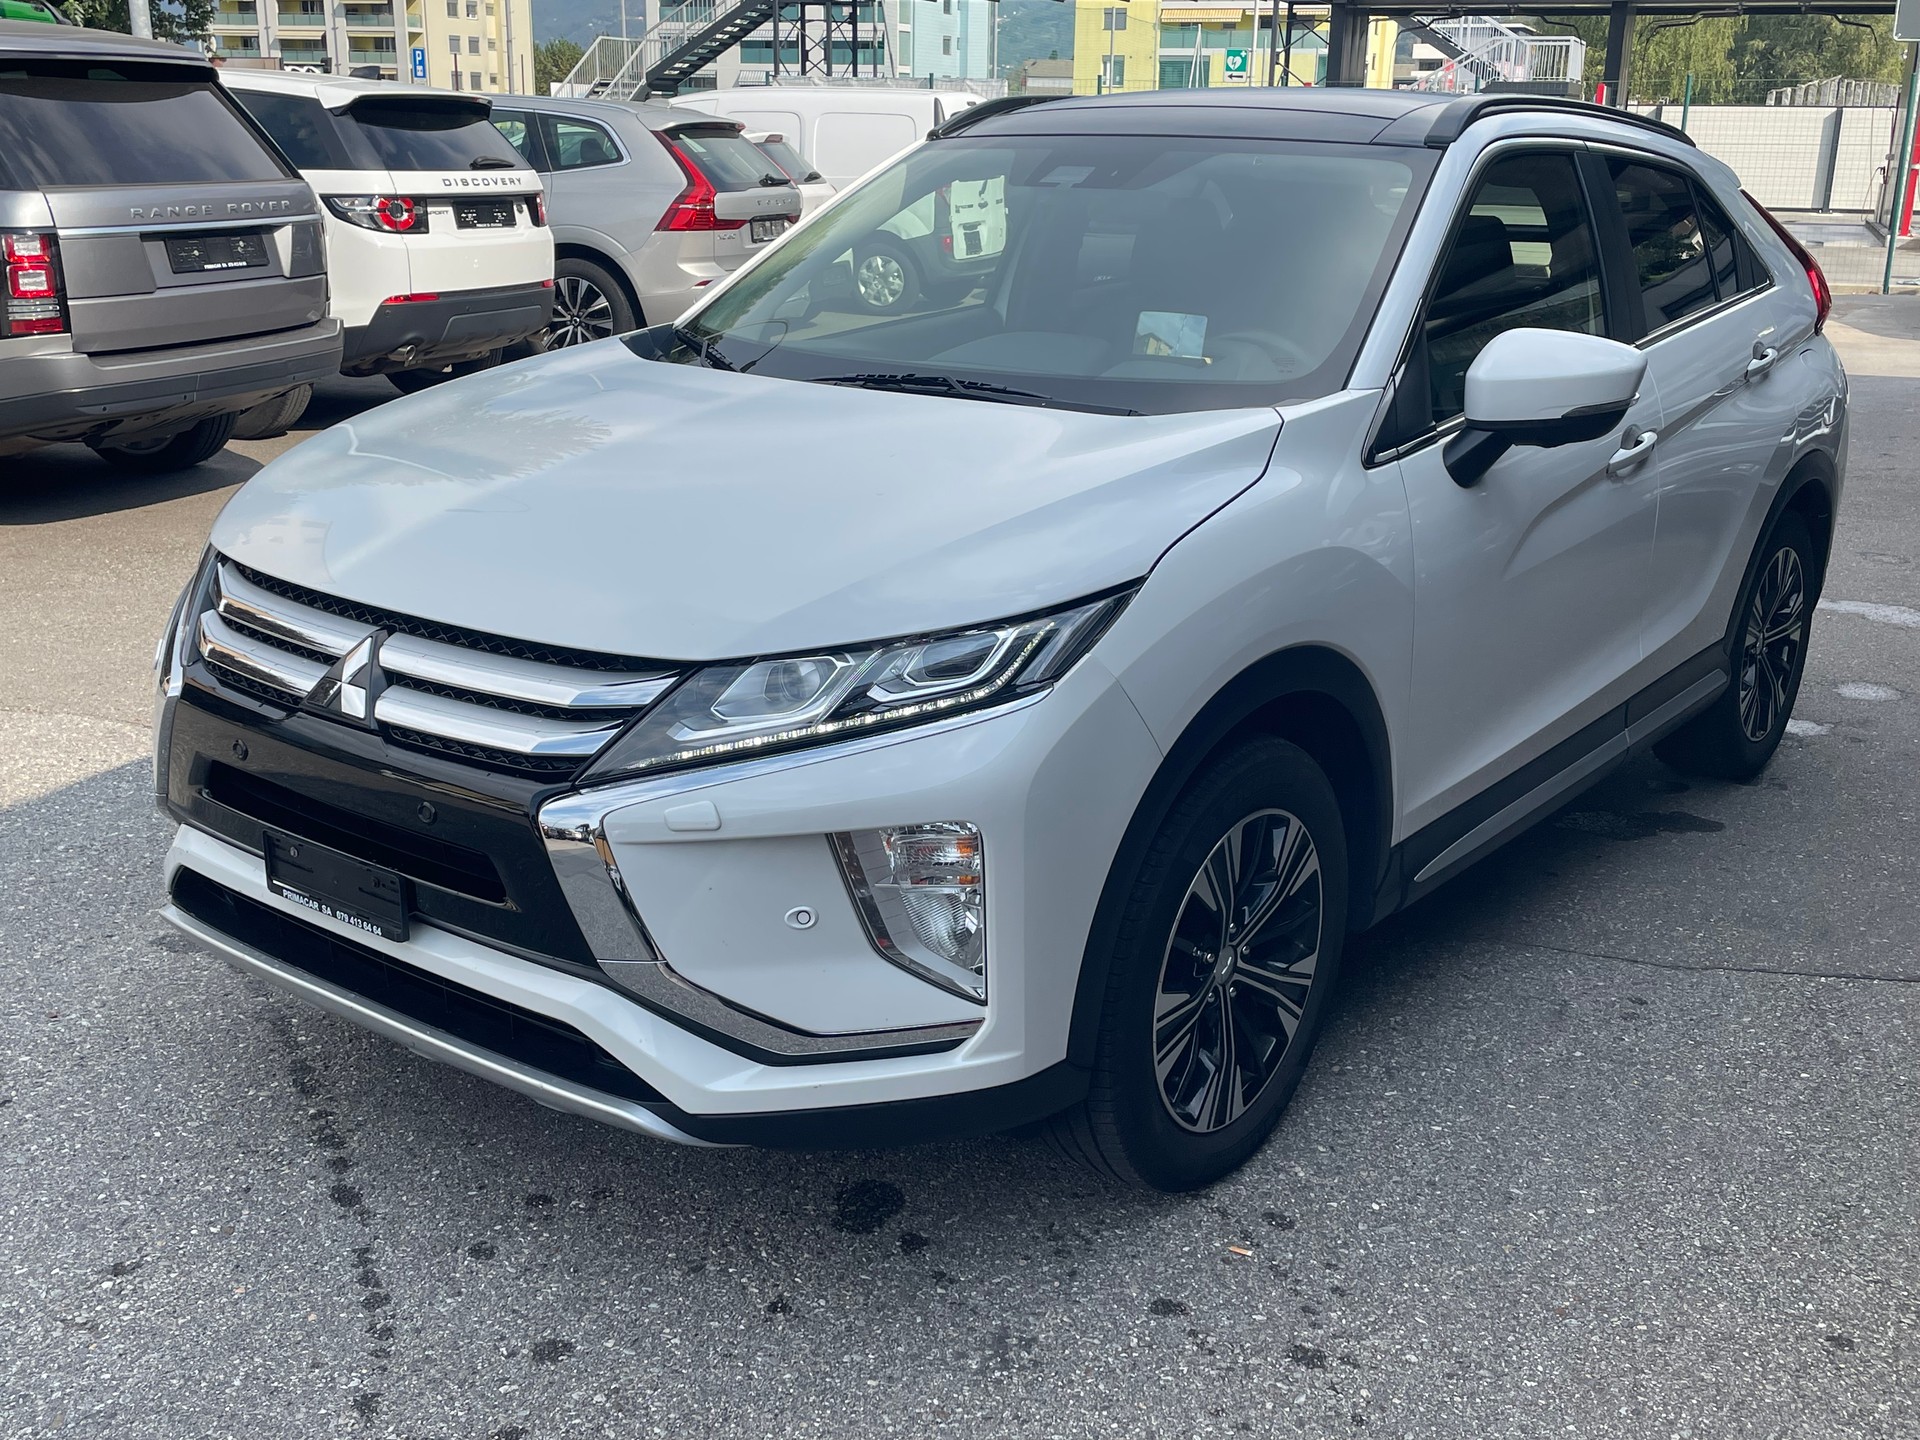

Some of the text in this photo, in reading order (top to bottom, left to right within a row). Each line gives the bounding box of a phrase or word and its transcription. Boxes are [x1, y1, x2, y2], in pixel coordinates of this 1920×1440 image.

[415, 50, 422, 65] P
[441, 177, 521, 187] DISCOVERY
[130, 200, 290, 219] RANGE ROVER
[282, 889, 320, 911] PRIMACAR
[321, 904, 333, 917] SA
[336, 910, 349, 923] 079
[349, 916, 362, 929] 413
[362, 921, 372, 932] 64
